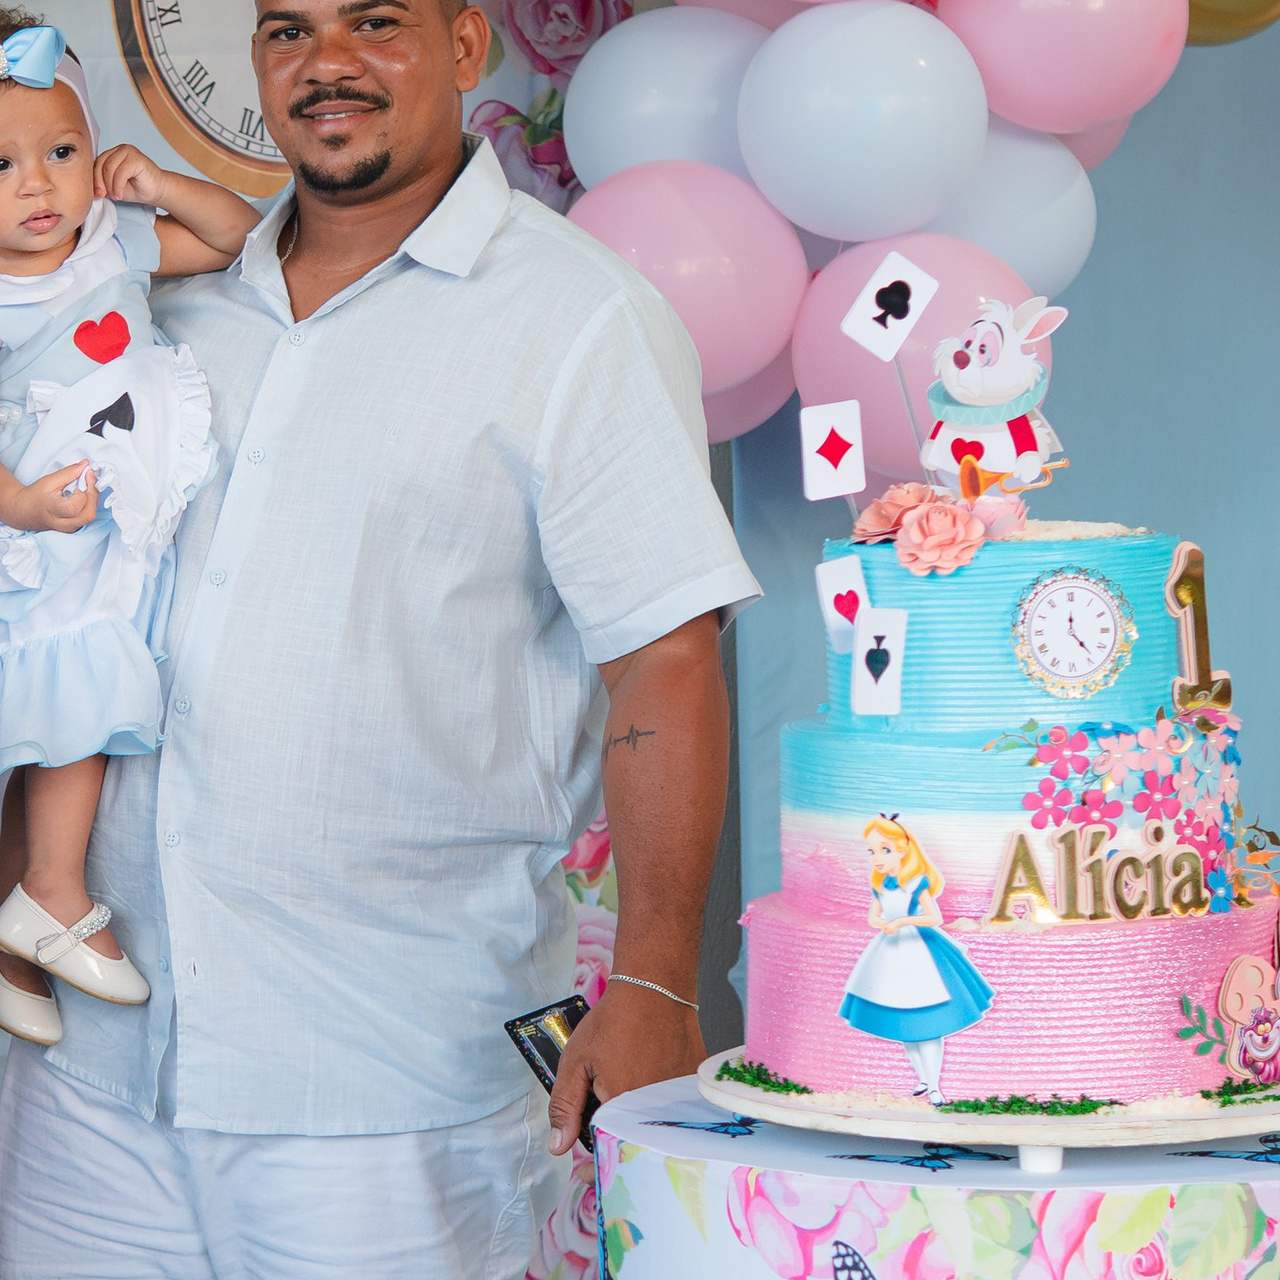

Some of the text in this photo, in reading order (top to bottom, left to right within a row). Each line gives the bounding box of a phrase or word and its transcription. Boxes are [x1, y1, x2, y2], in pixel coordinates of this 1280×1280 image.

[157, 0, 182, 28] IX
[182, 59, 216, 106] VIII
[240, 108, 265, 142] VII
[1166, 542, 1232, 712] 1
